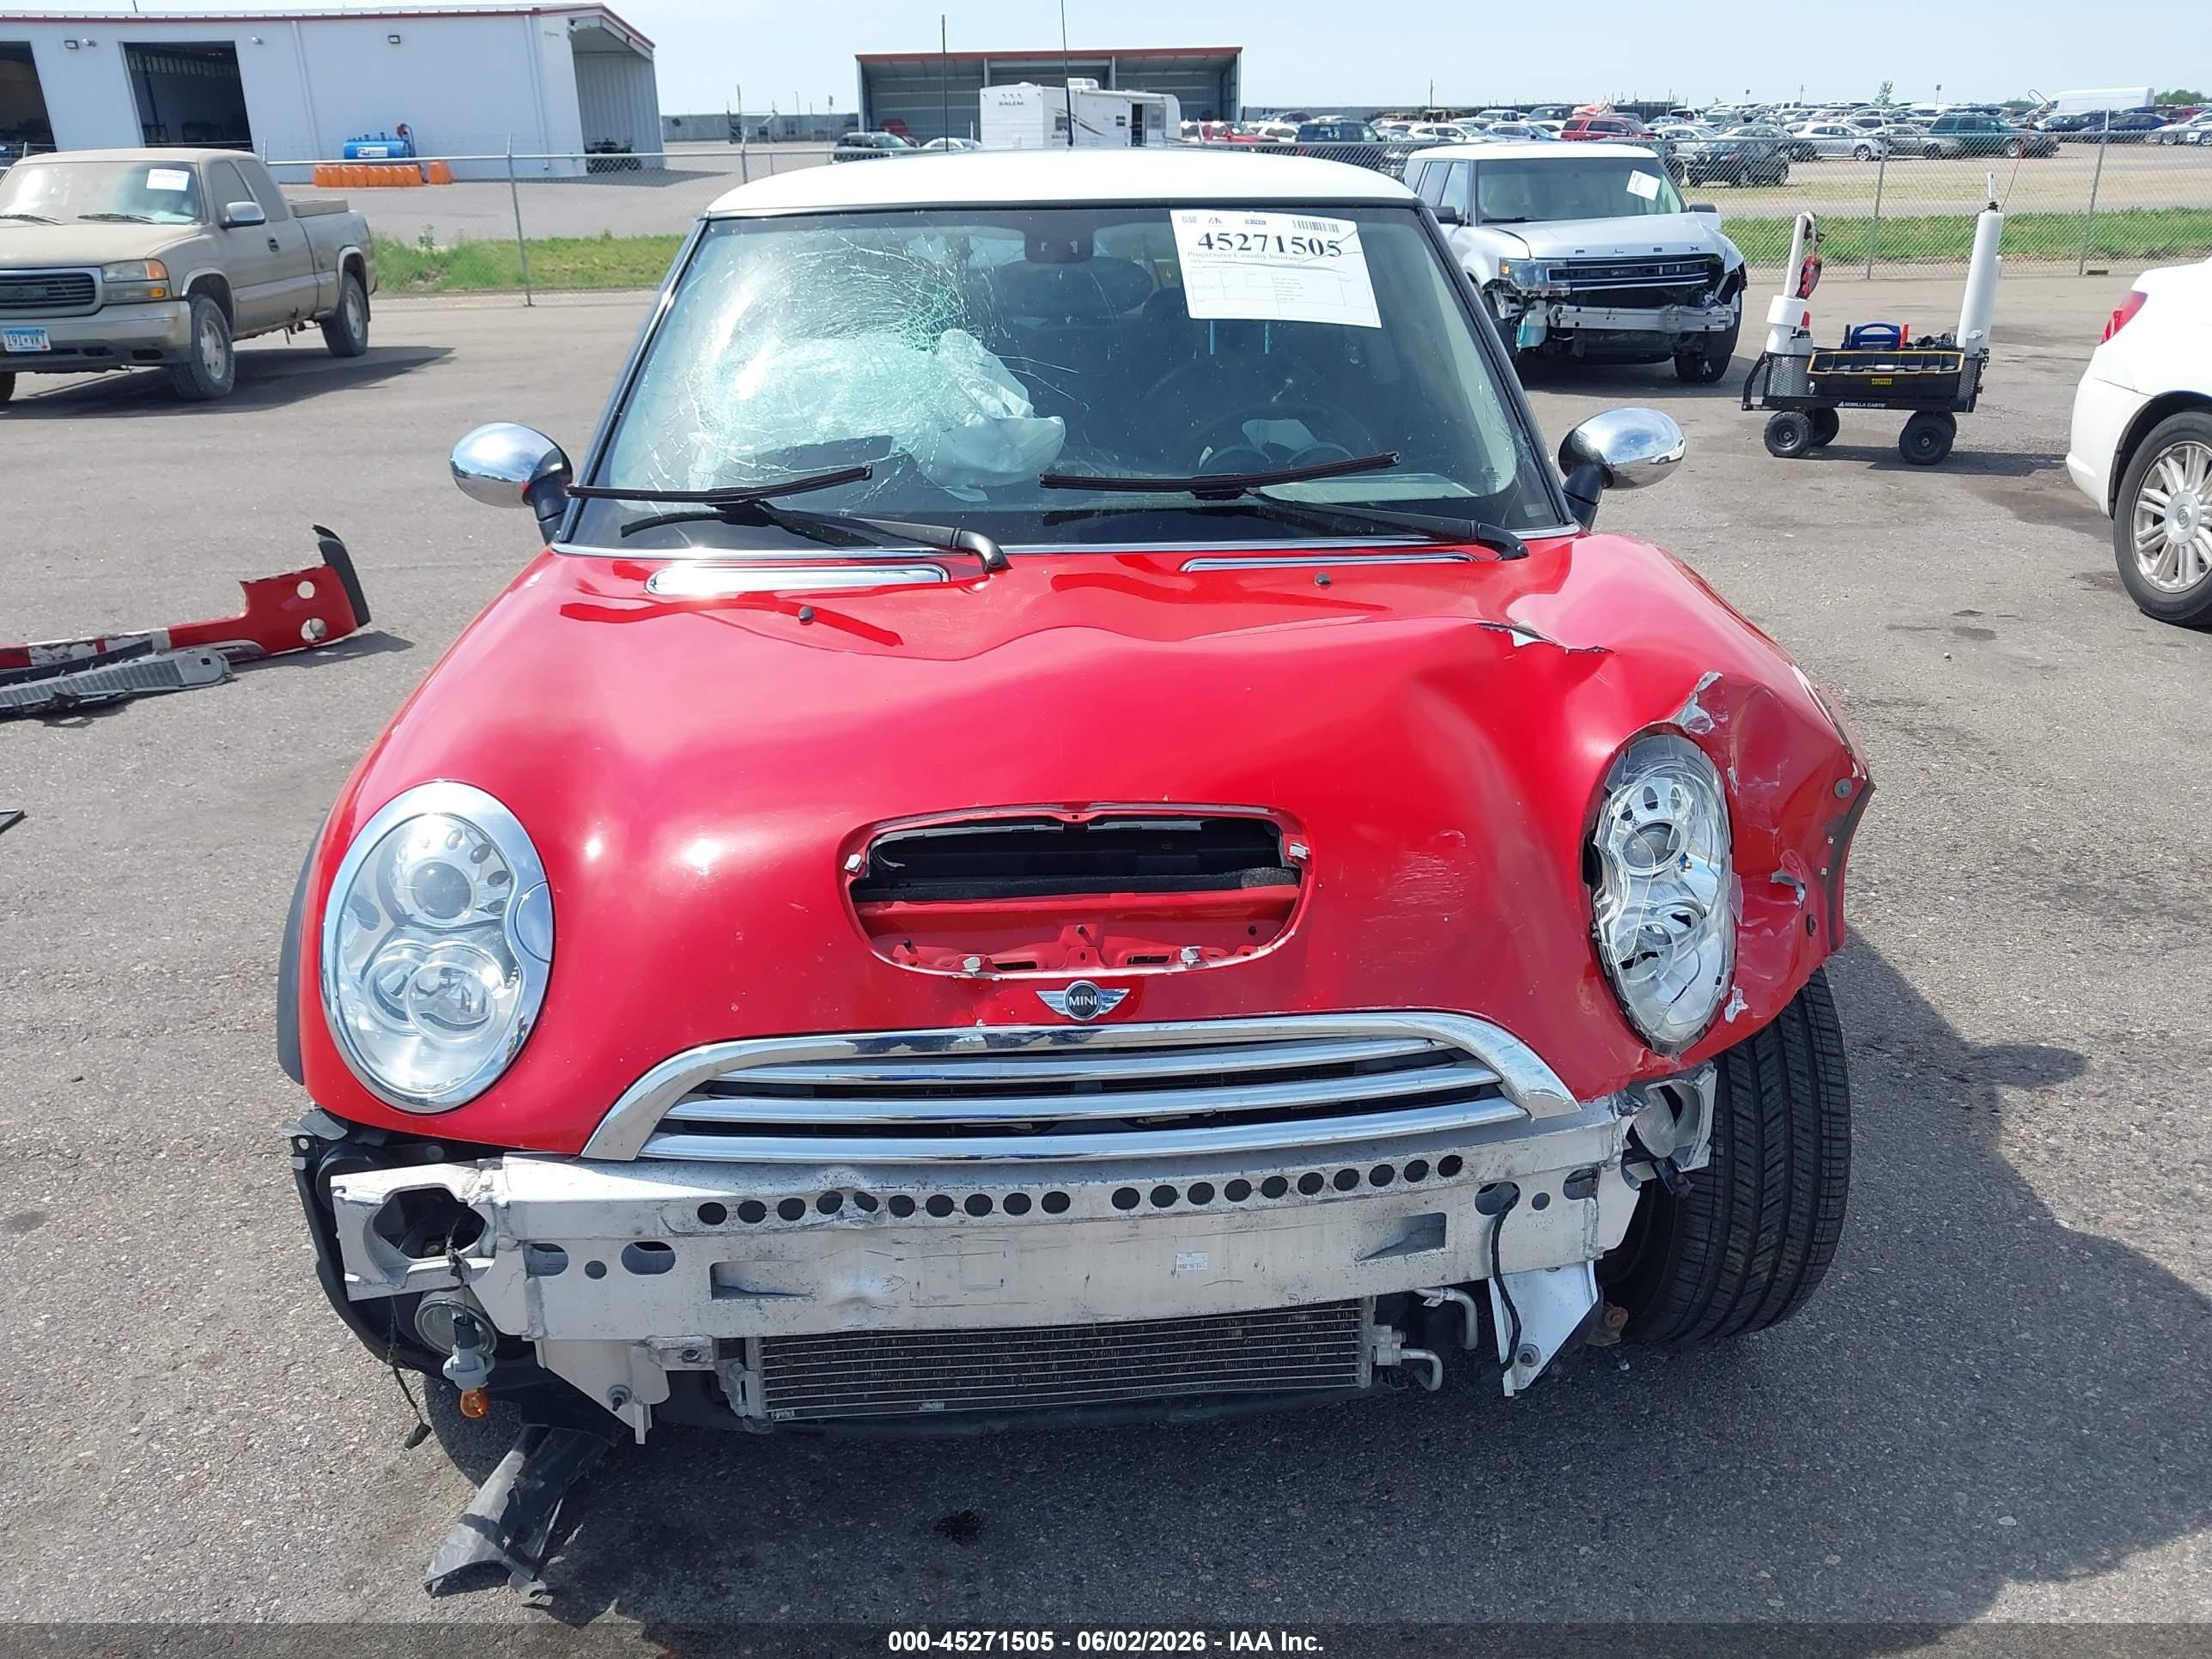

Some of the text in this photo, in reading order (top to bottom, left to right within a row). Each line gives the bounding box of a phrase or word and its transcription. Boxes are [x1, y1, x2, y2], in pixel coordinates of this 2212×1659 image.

[1197, 231, 1342, 258] 45271505
[1188, 251, 1232, 259] Progressive
[1068, 995, 1097, 1006] MINI
